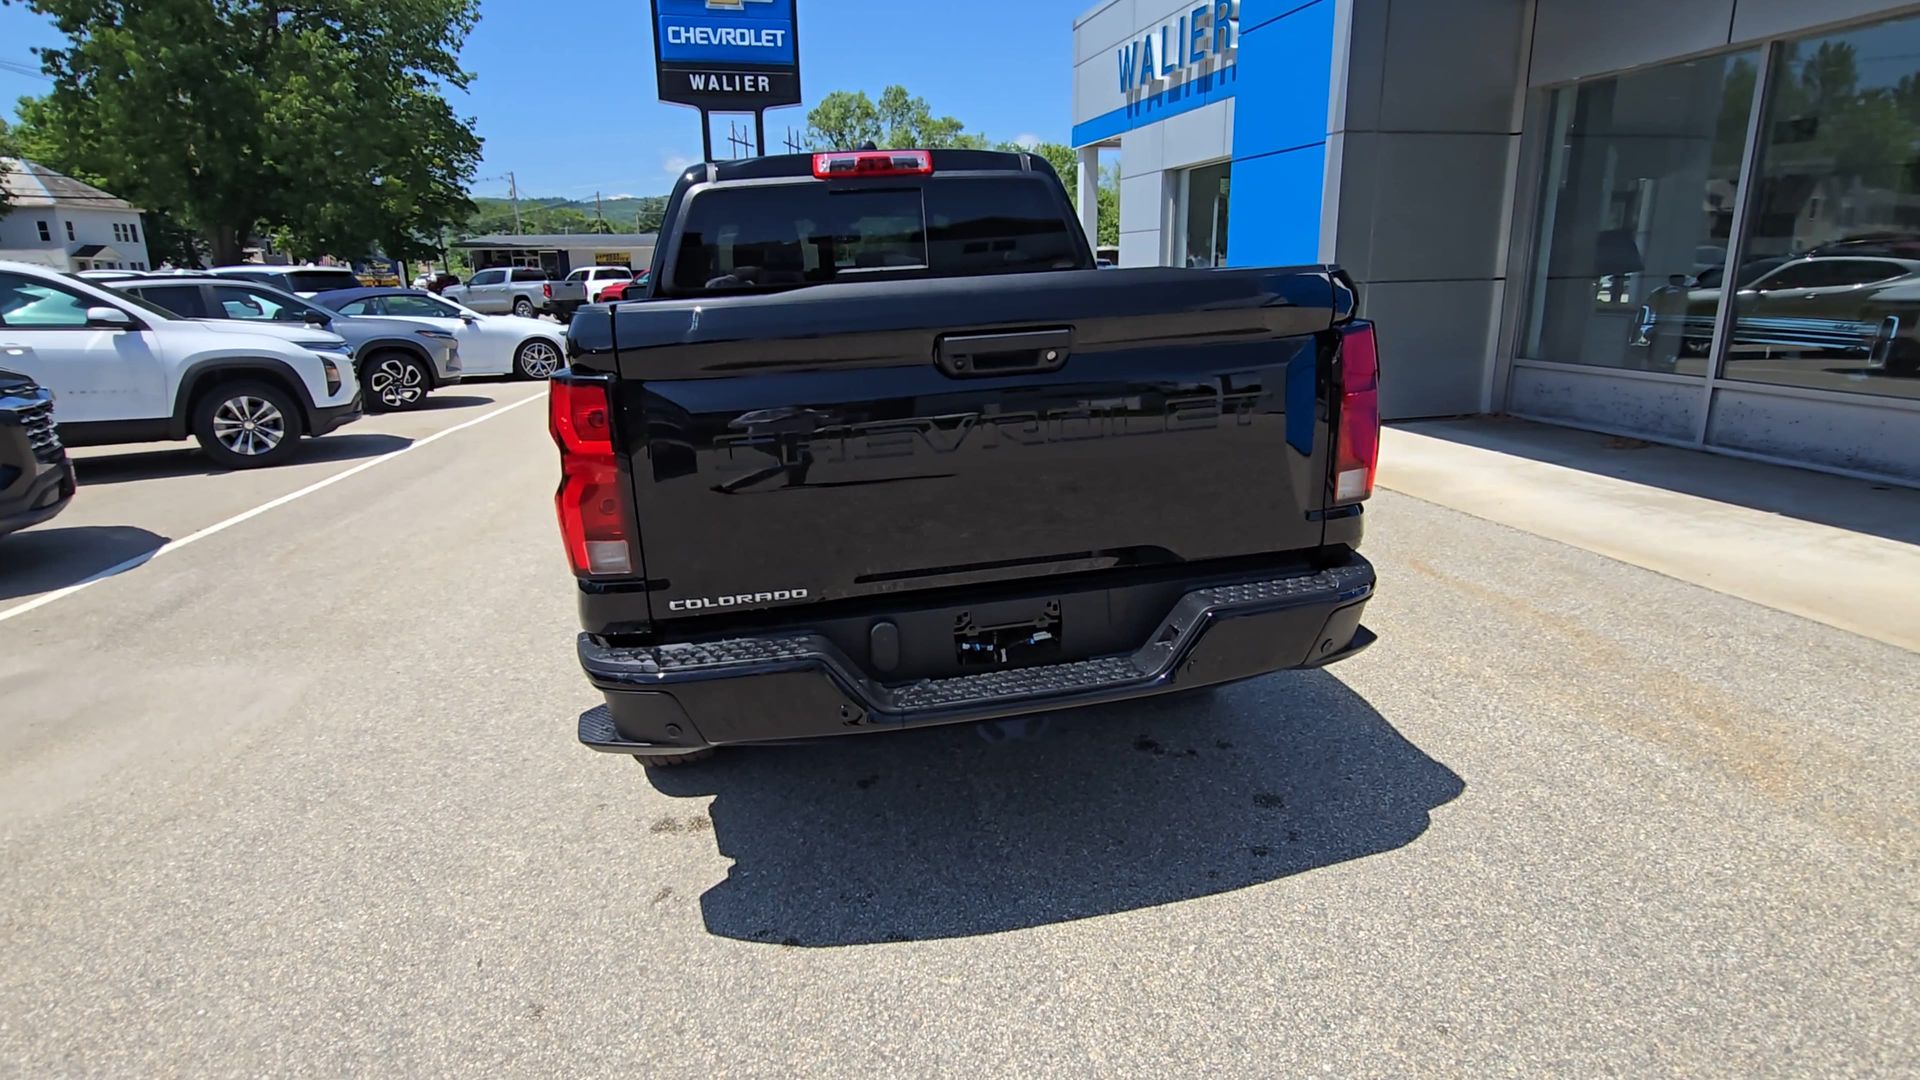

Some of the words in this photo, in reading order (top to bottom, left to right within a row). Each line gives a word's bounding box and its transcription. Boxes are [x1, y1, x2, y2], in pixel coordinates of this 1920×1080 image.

[667, 26, 785, 47] CHEVROLET
[1117, 0, 1238, 94] WALIER
[688, 73, 770, 92] WALIER
[668, 588, 808, 611] COLORADO
